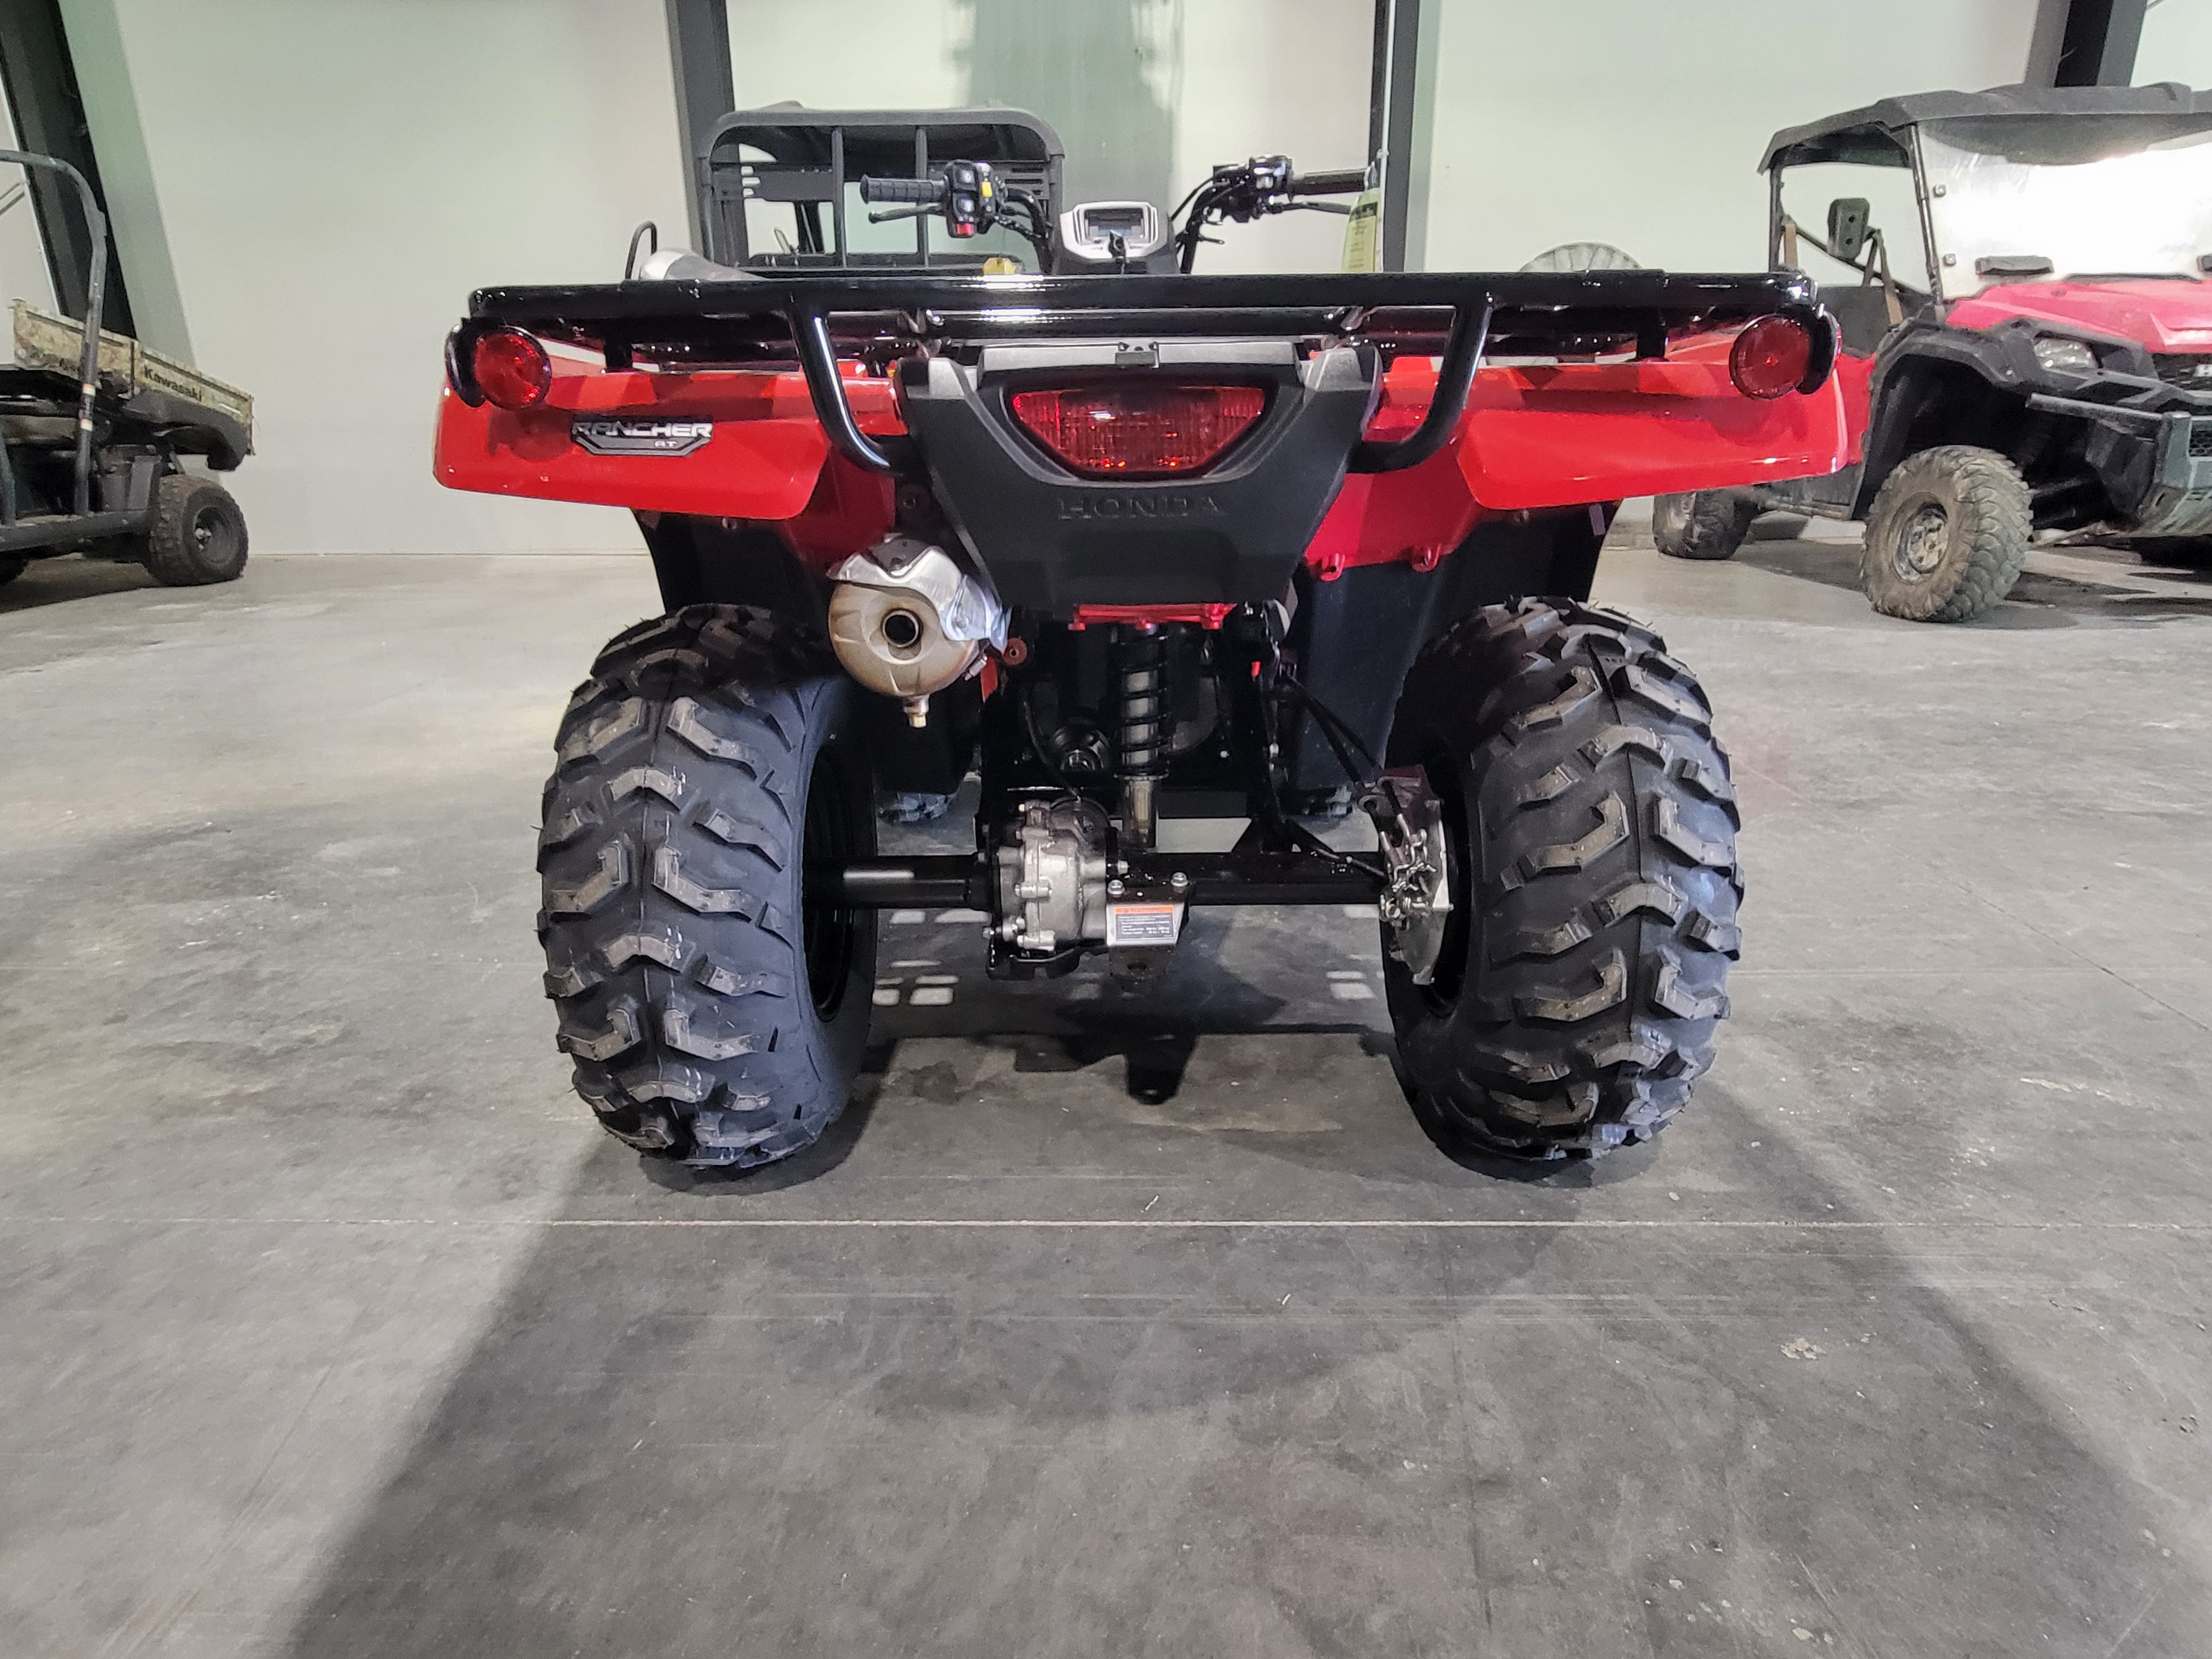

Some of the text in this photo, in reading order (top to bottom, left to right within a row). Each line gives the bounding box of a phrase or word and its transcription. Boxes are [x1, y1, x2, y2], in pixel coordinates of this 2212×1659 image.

[144, 364, 202, 402] Kawasaki
[572, 421, 713, 438] RANCHER
[1058, 496, 1229, 520] HONDA
